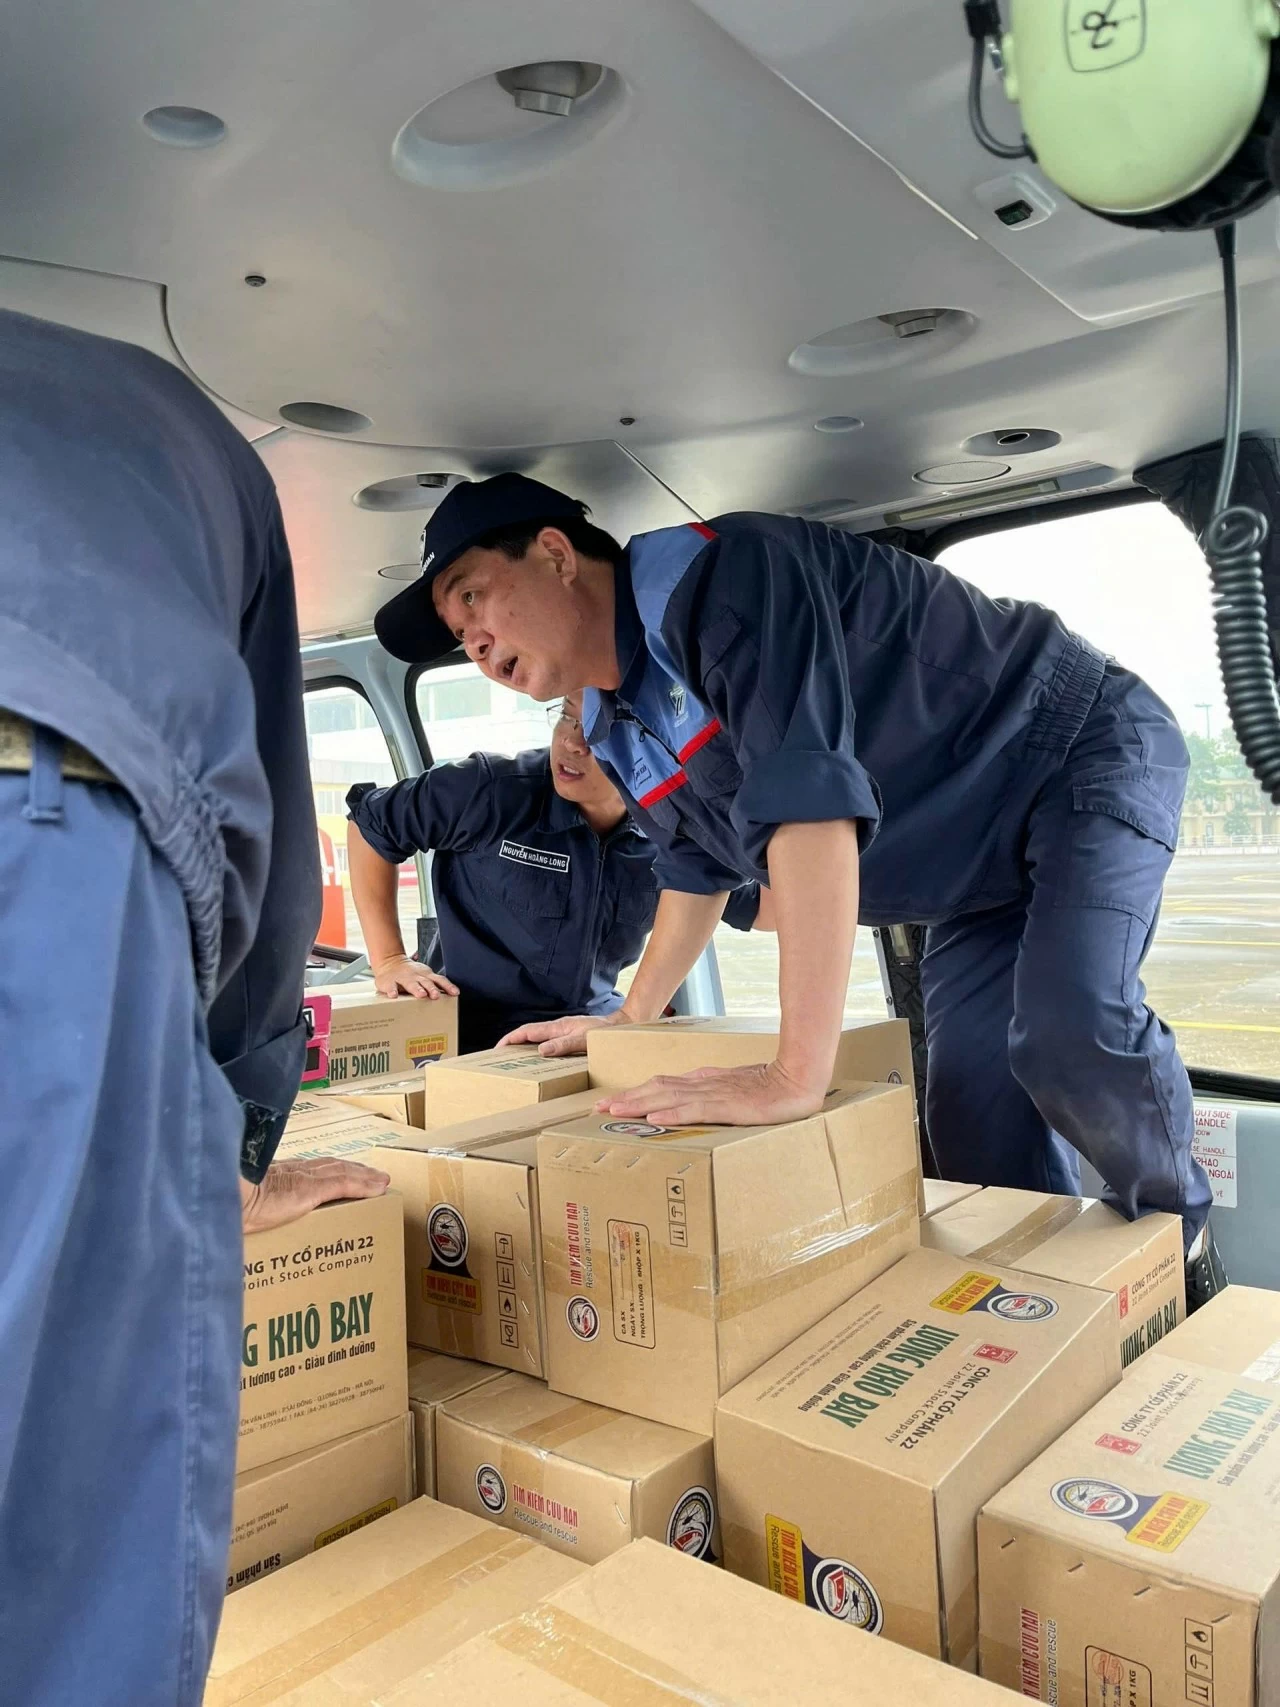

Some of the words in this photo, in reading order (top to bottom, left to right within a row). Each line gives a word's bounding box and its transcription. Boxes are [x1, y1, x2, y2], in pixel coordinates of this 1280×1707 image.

[503, 845, 528, 860] NGUYỄN
[528, 853, 548, 864] HOÀNG
[549, 858, 566, 868] LONG
[1195, 1109, 1231, 1119] OUTSIDE
[270, 1255, 289, 1270] TY
[358, 1236, 374, 1250] 22
[584, 1238, 592, 1254] and
[280, 1266, 314, 1282] Stock
[318, 1253, 374, 1272] Company
[268, 1303, 320, 1362] KHÔ
[330, 1292, 374, 1343] BAY
[1164, 1296, 1177, 1336] BAY
[886, 1324, 960, 1368] LƯƠNG
[278, 1365, 295, 1378] cao
[328, 1348, 346, 1364] dinh
[962, 1366, 990, 1388] CÔNG
[854, 1362, 914, 1398] KHÔ
[944, 1372, 966, 1388] Joint
[820, 1392, 880, 1428] BAY
[922, 1388, 948, 1408] Stock
[950, 1390, 968, 1401] TY
[885, 1410, 926, 1444] Company
[900, 1436, 918, 1450] 22
[514, 1508, 538, 1526] Rescue
[540, 1520, 552, 1533] and
[554, 1528, 578, 1544] rescue
[770, 1524, 780, 1559] Rescue
[773, 1561, 782, 1582] and
[1047, 1620, 1057, 1651] rescue
[1047, 1656, 1057, 1678] and
